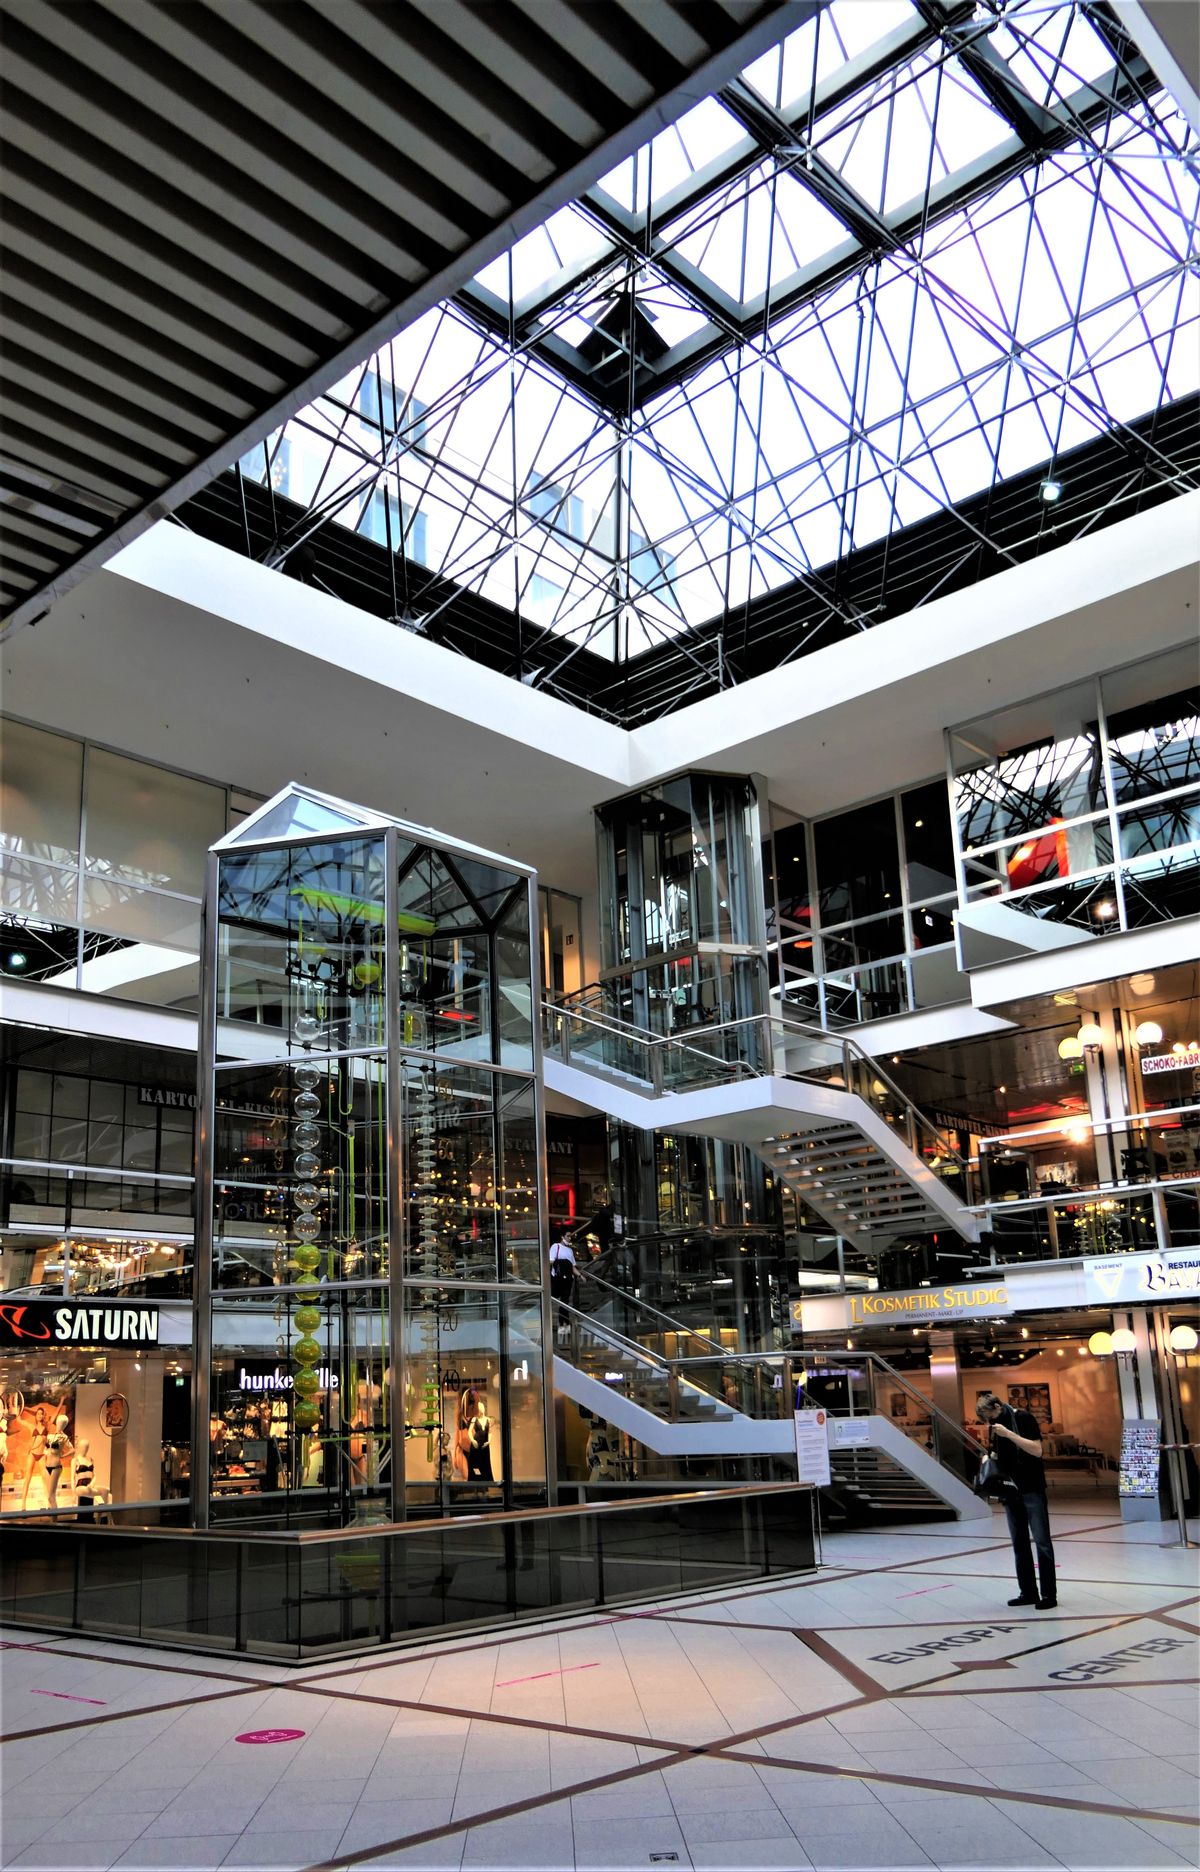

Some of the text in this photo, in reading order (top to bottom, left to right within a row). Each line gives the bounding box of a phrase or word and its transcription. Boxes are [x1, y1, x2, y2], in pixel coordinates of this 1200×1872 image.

[1143, 1053, 1199, 1072] SCHOKO-FABR
[1168, 1260, 1200, 1270] RESTAU
[862, 1287, 1008, 1314] KOSMETIK STUDIO
[55, 1308, 158, 1340] SATURN
[240, 1367, 338, 1390] hunkelle
[868, 1624, 1029, 1665] EUROPA
[1048, 1637, 1196, 1682] CENTER
